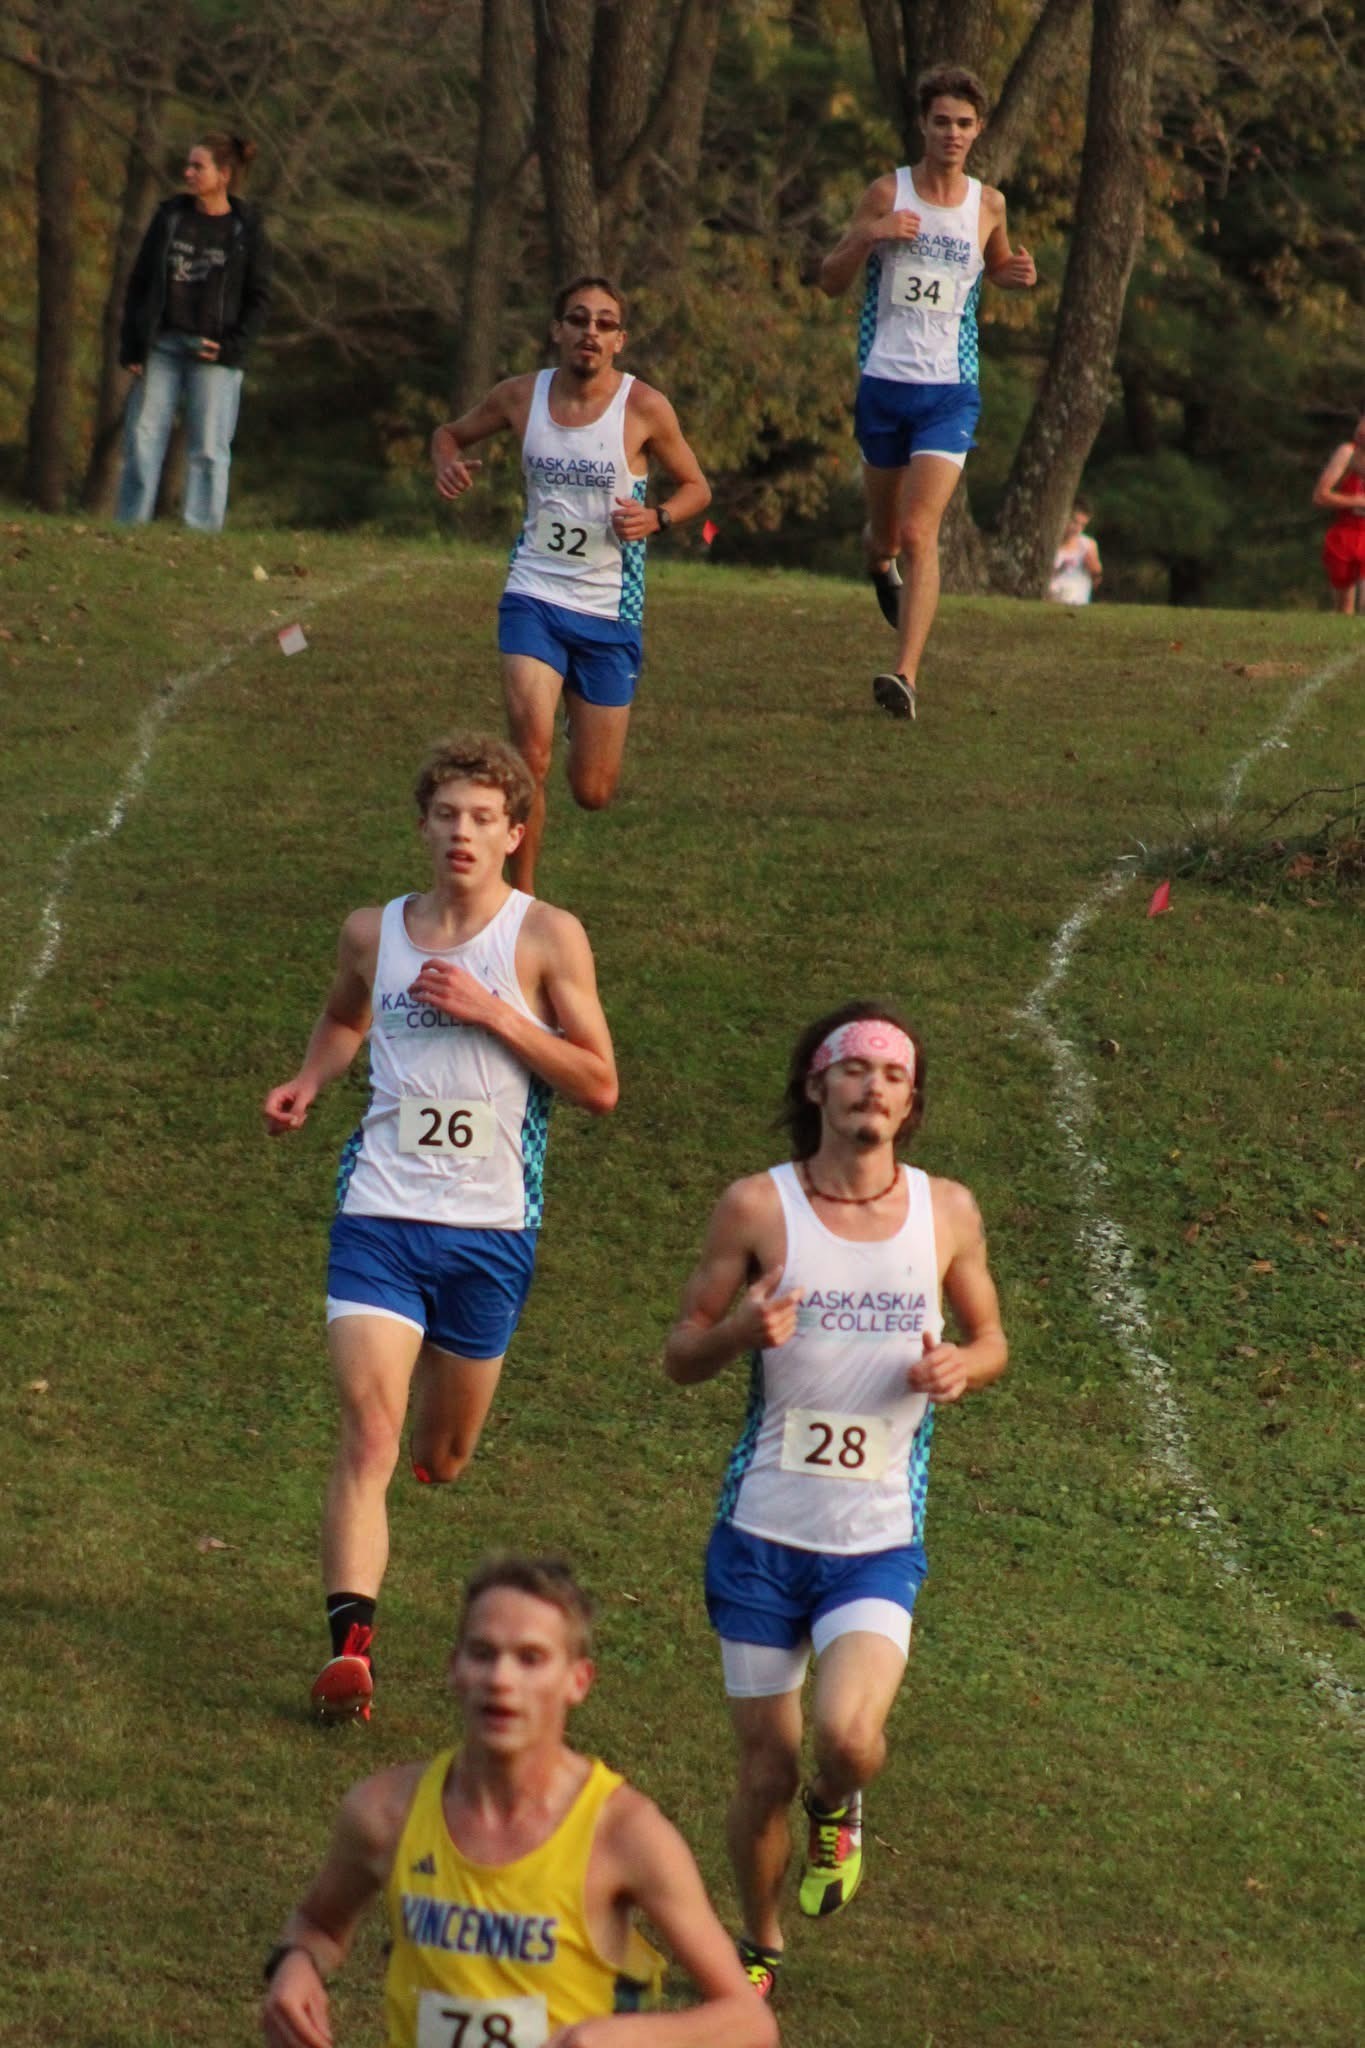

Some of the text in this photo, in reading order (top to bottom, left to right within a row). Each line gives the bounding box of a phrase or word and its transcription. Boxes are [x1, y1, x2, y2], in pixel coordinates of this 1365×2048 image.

[911, 243, 970, 265] COLLEGE
[905, 276, 941, 305] 34
[528, 456, 616, 474] KASKASKIA
[544, 472, 616, 489] COLLEGE
[547, 522, 588, 557] 32
[418, 1107, 474, 1148] 26
[821, 1312, 925, 1332] COLLEGE
[804, 1422, 867, 1469] 28
[402, 1895, 557, 1964] VINCENNES
[441, 2009, 517, 2048] 78
